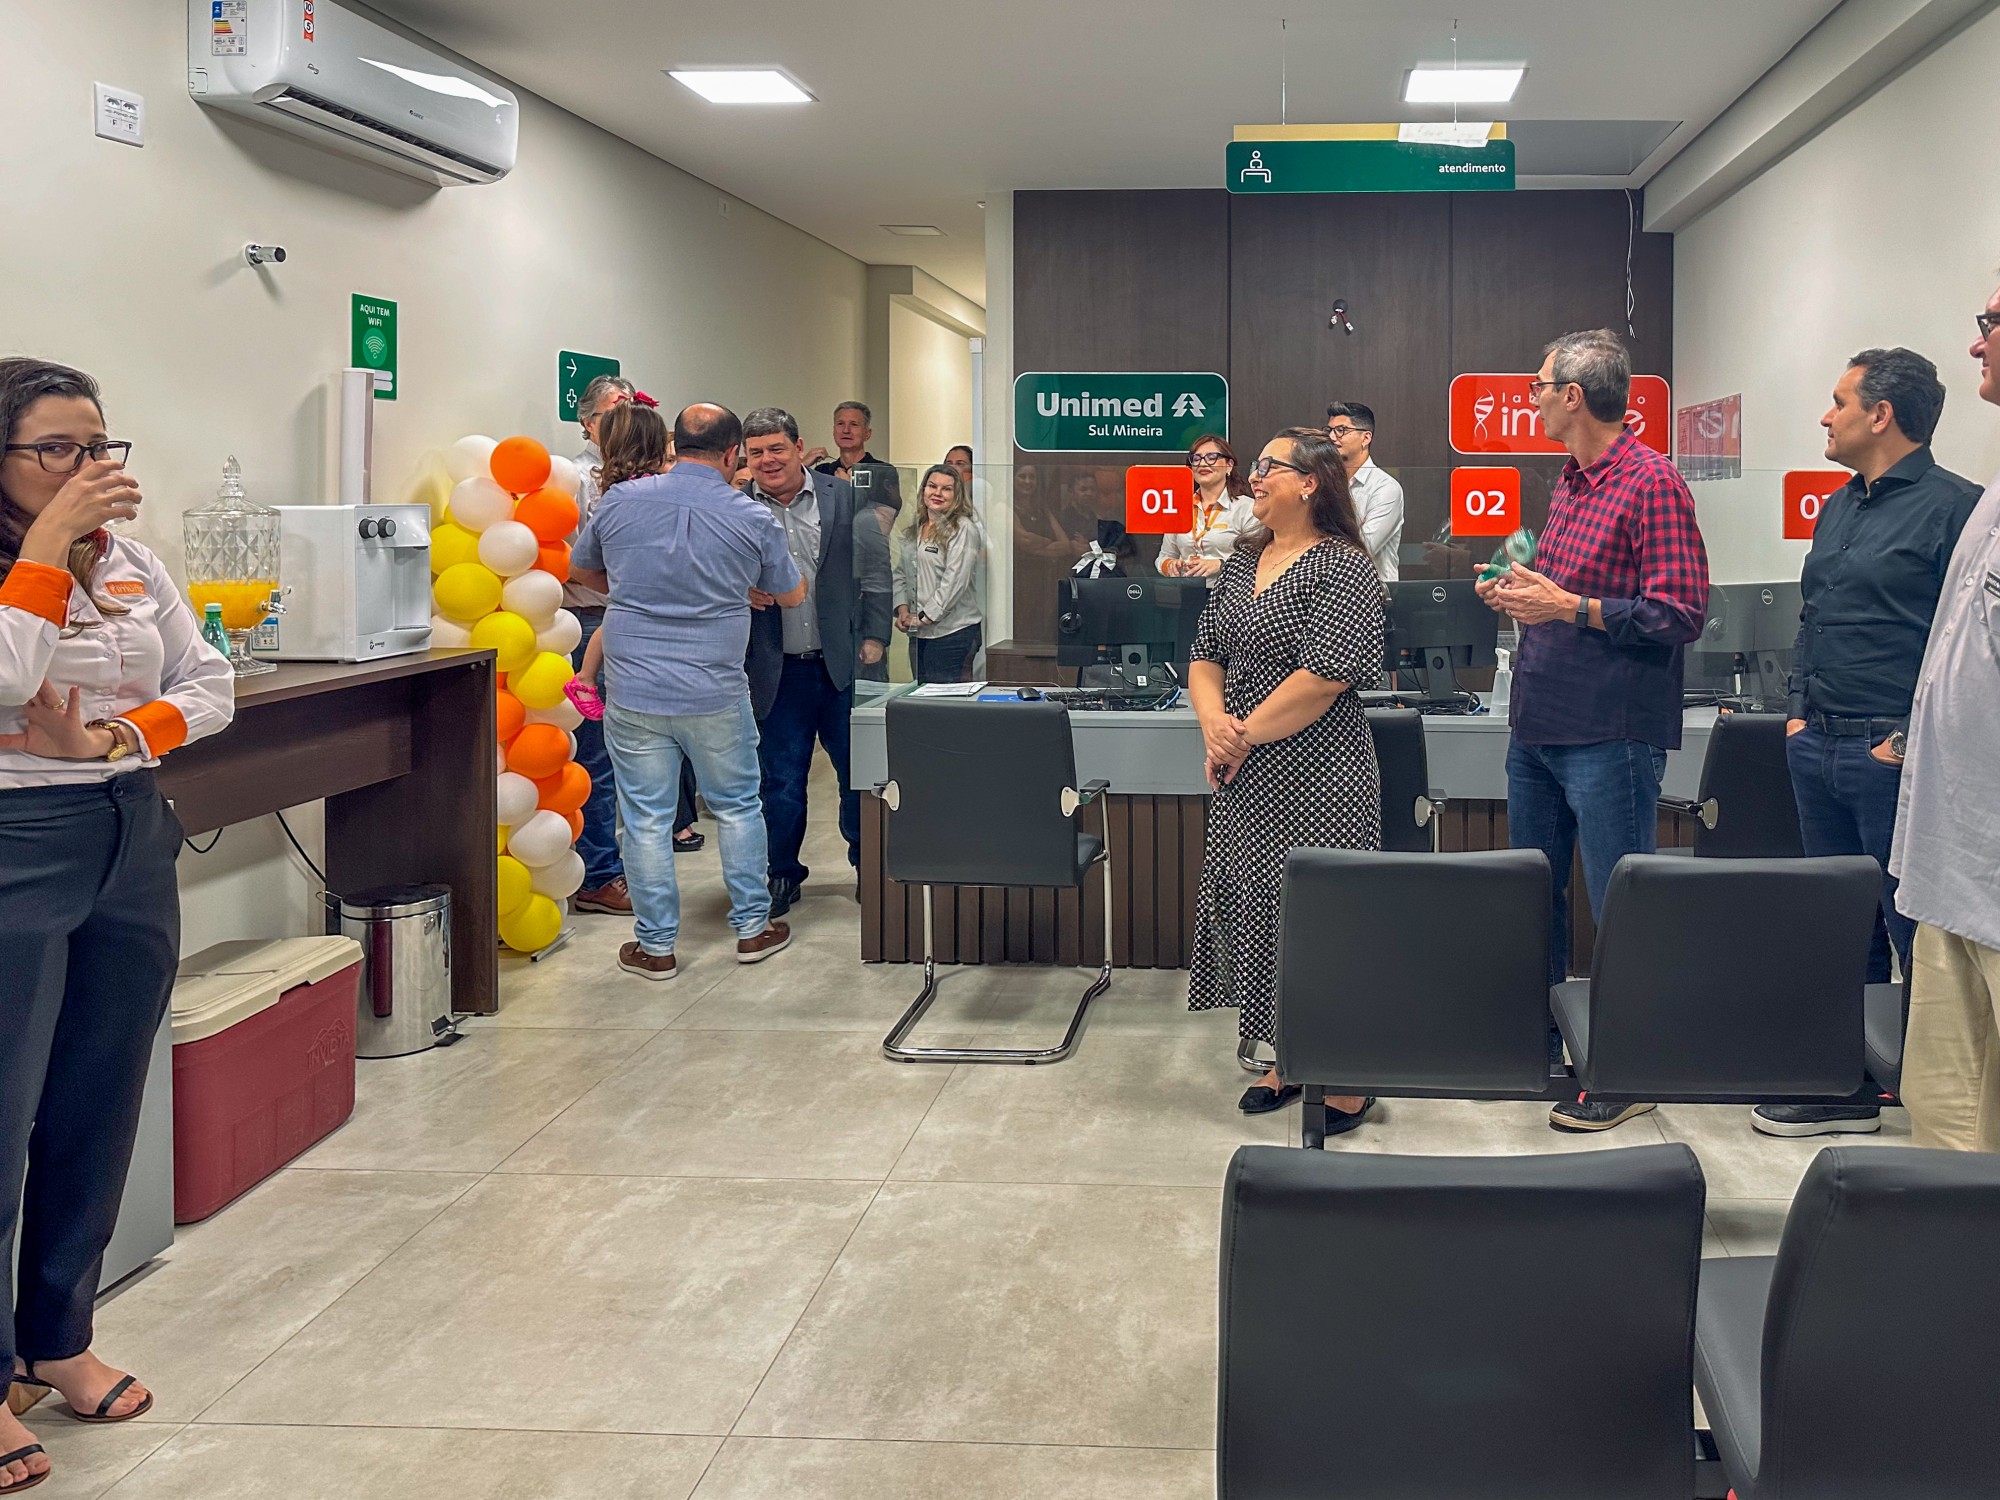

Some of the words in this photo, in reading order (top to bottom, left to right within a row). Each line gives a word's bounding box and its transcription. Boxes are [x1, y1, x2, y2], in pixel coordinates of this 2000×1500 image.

[1439, 163, 1506, 173] atendimento
[359, 303, 376, 315] AQUI
[377, 306, 390, 317] TEM
[368, 317, 382, 327] WIFI
[1036, 391, 1163, 417] Unimed
[1088, 424, 1110, 436] Sul
[1113, 424, 1163, 436] Mineira
[1141, 488, 1178, 514] 01
[1465, 490, 1506, 516] 02
[1799, 493, 1832, 520] 0
